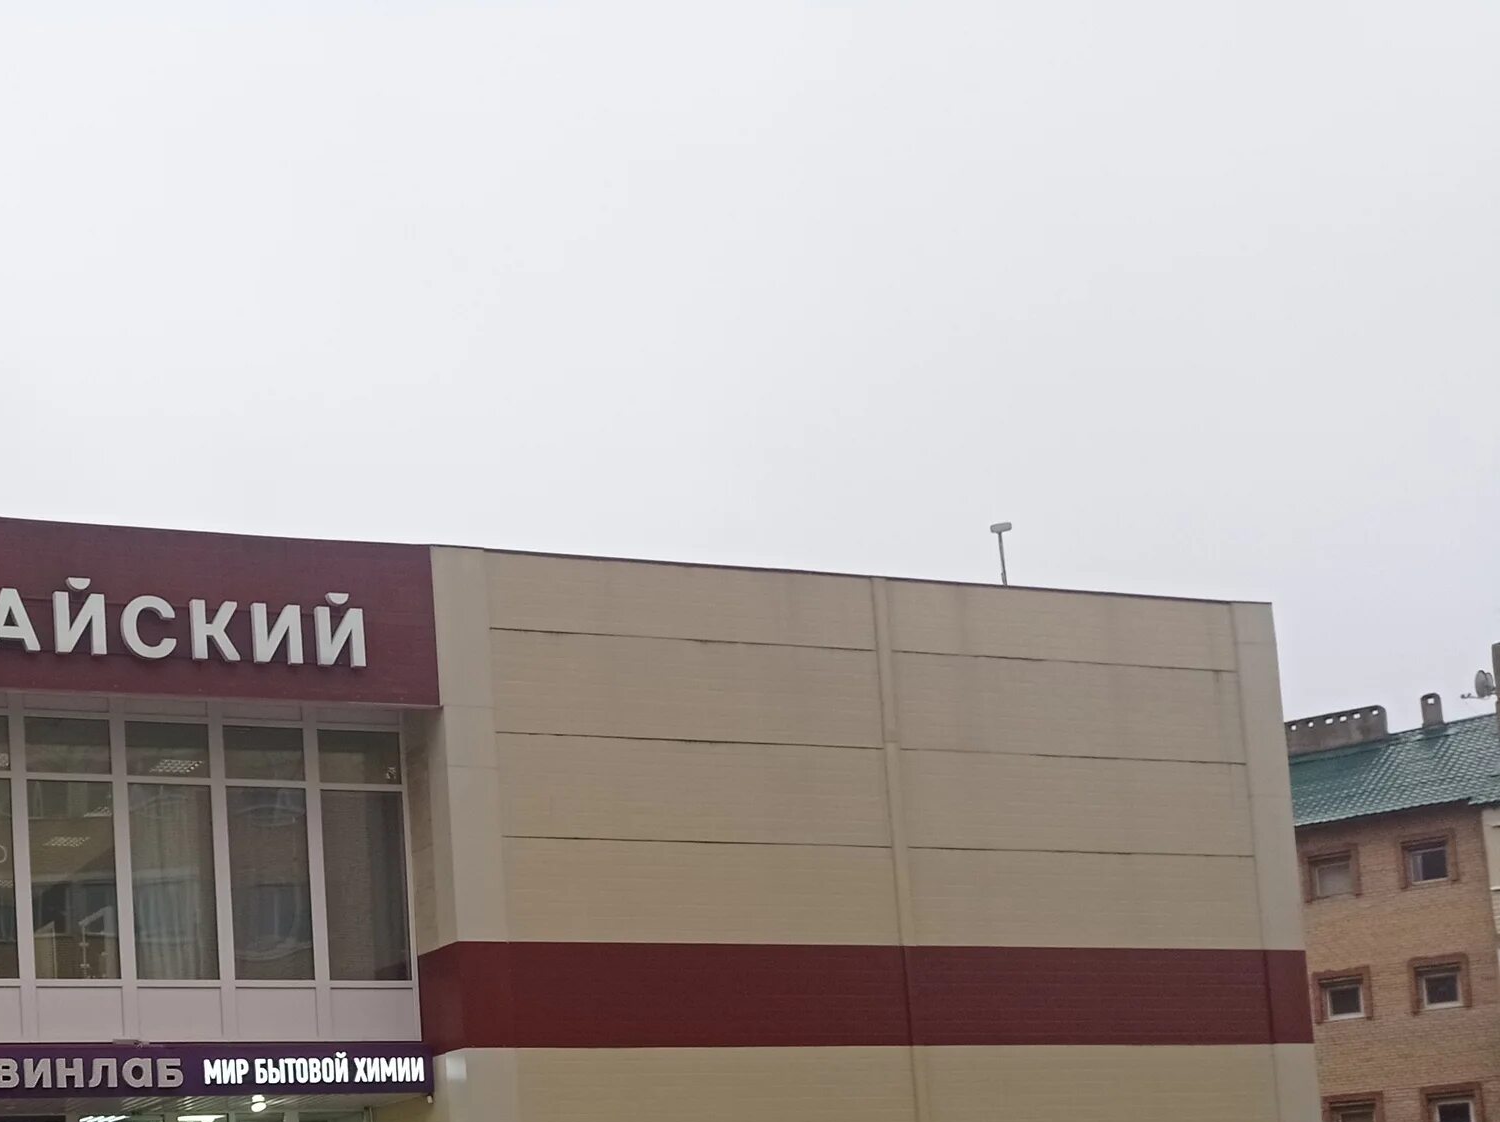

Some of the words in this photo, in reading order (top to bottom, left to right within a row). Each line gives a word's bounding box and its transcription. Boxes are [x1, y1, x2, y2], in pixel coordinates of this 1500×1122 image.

[203, 1056, 249, 1086] МИР
[253, 1051, 348, 1085] БЫТОВОЙ
[353, 1056, 426, 1083] ХИМИИ
